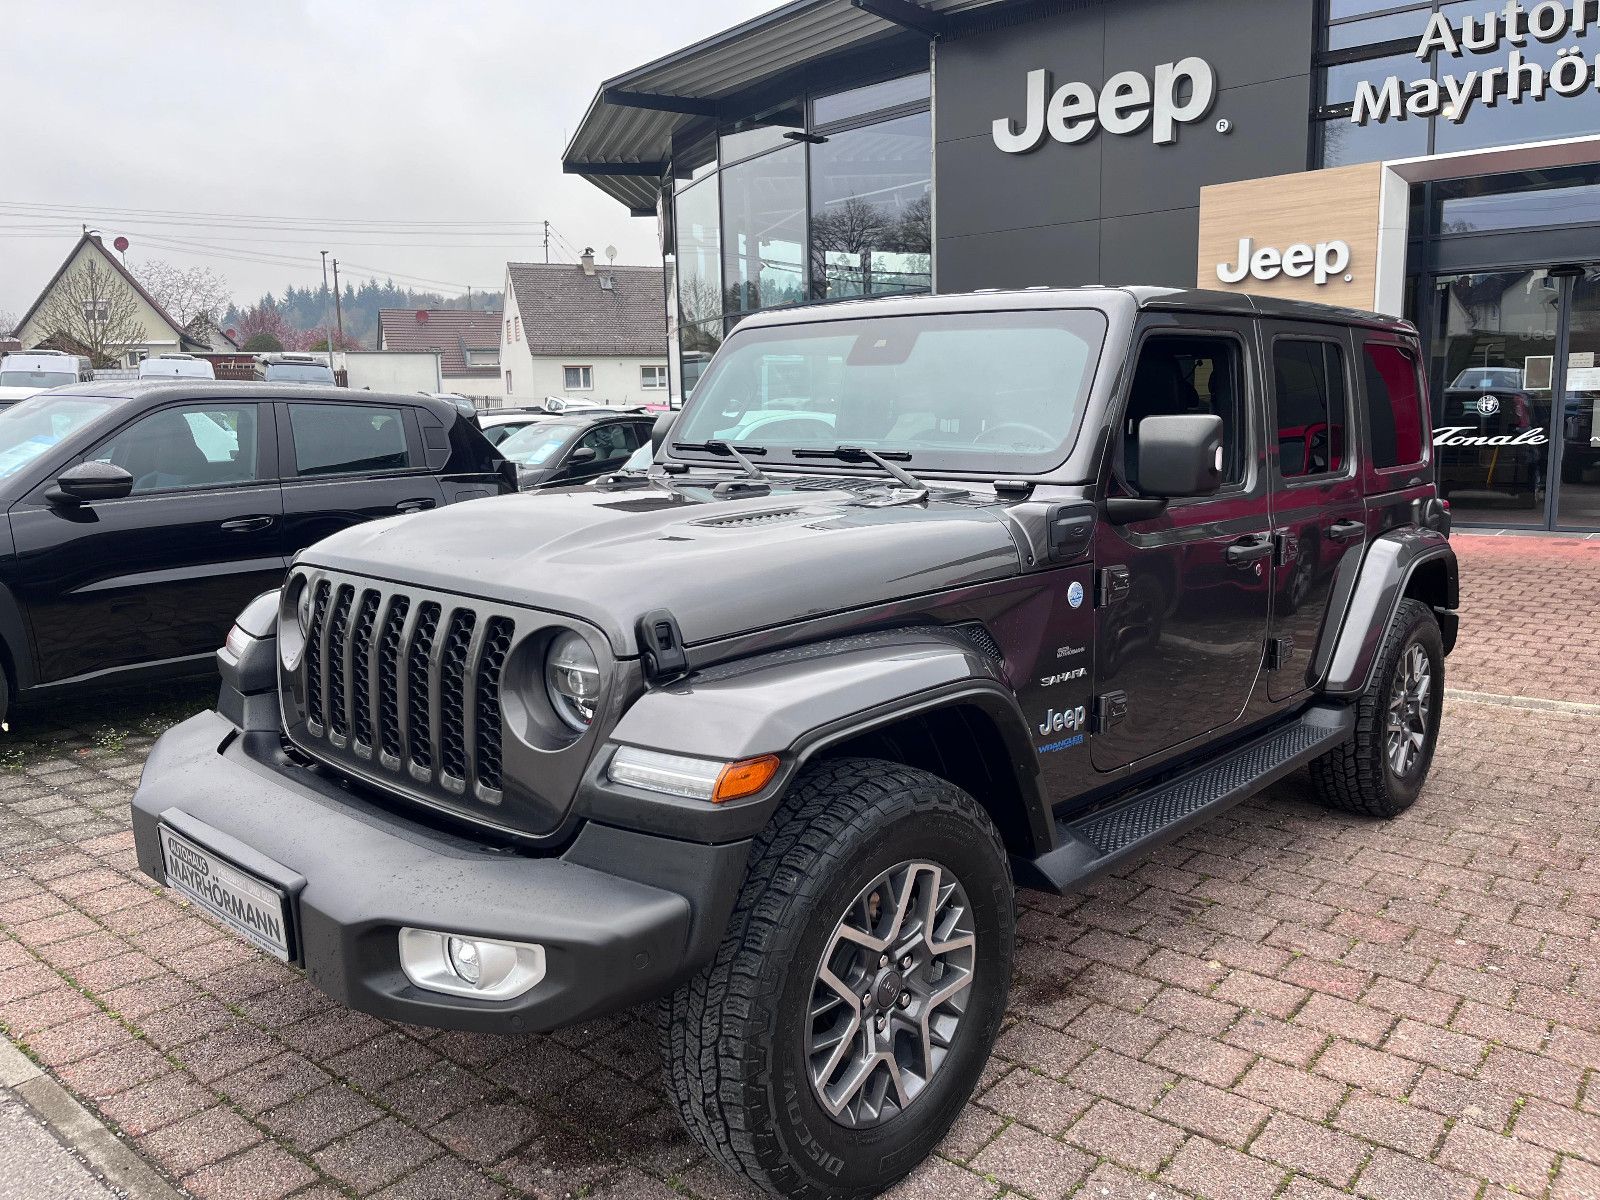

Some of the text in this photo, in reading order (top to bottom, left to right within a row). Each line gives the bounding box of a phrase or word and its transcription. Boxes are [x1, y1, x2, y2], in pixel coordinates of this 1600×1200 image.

[992, 56, 1215, 153] Jeep
[1216, 238, 1349, 285] Jeep
[1432, 426, 1548, 447] Tonale
[1040, 667, 1087, 687] SAHARA
[1039, 705, 1086, 735] Jeep
[1038, 734, 1084, 753] WRANGLER
[169, 841, 207, 875] AUTOHAUS
[169, 854, 281, 942] MAYRHÖRMANN
